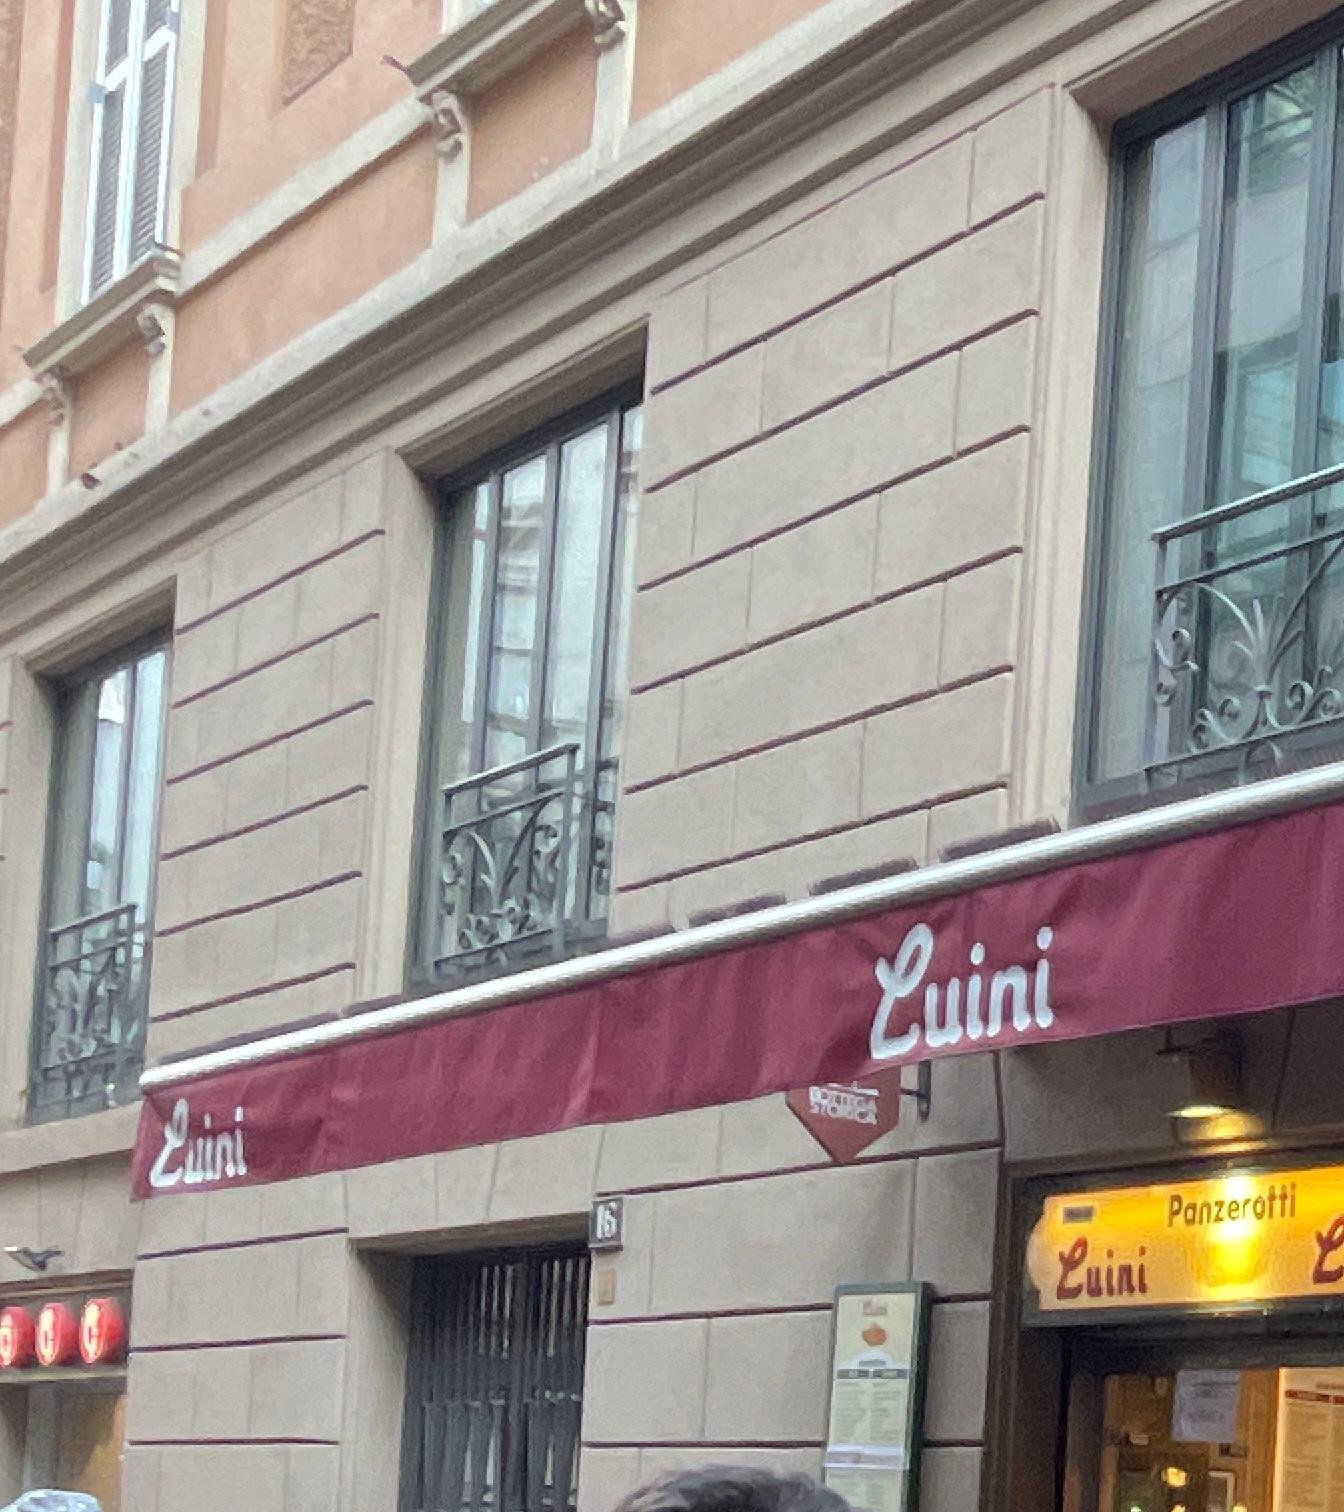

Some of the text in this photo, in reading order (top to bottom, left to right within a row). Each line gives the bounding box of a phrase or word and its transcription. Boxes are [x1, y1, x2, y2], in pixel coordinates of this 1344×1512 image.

[870, 922, 1054, 1059] Luini
[149, 1098, 248, 1188] Luini
[1166, 1182, 1297, 1228] Panzerotti
[1056, 1236, 1148, 1299] Luini
